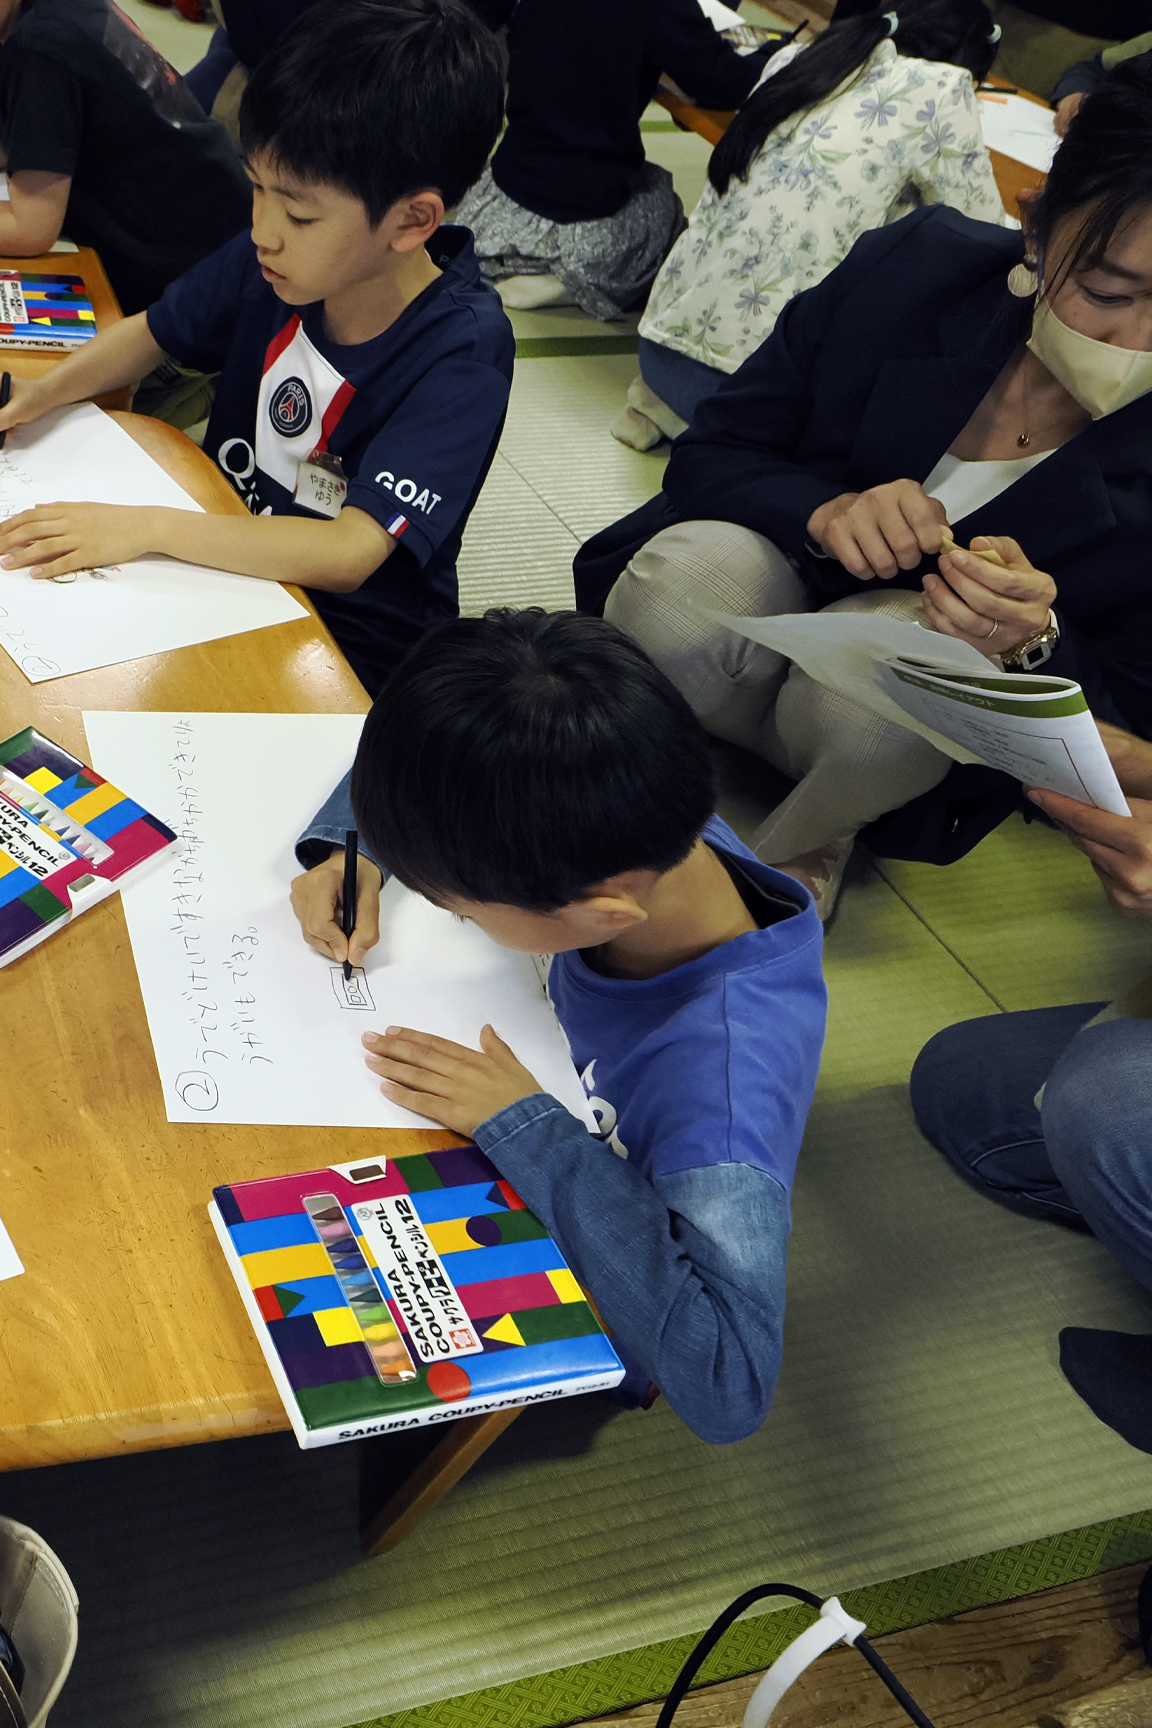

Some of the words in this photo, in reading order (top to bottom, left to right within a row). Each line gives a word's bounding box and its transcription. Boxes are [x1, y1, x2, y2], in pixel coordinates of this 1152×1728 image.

[287, 384, 305, 407] PARIS
[374, 471, 442, 516] GOAT
[375, 1202, 450, 1354] COUPY-PENCIL
[387, 1268, 435, 1358] SAKURA
[338, 1416, 421, 1442] SAKURA
[428, 1388, 568, 1423] COUPY-PENCIL
